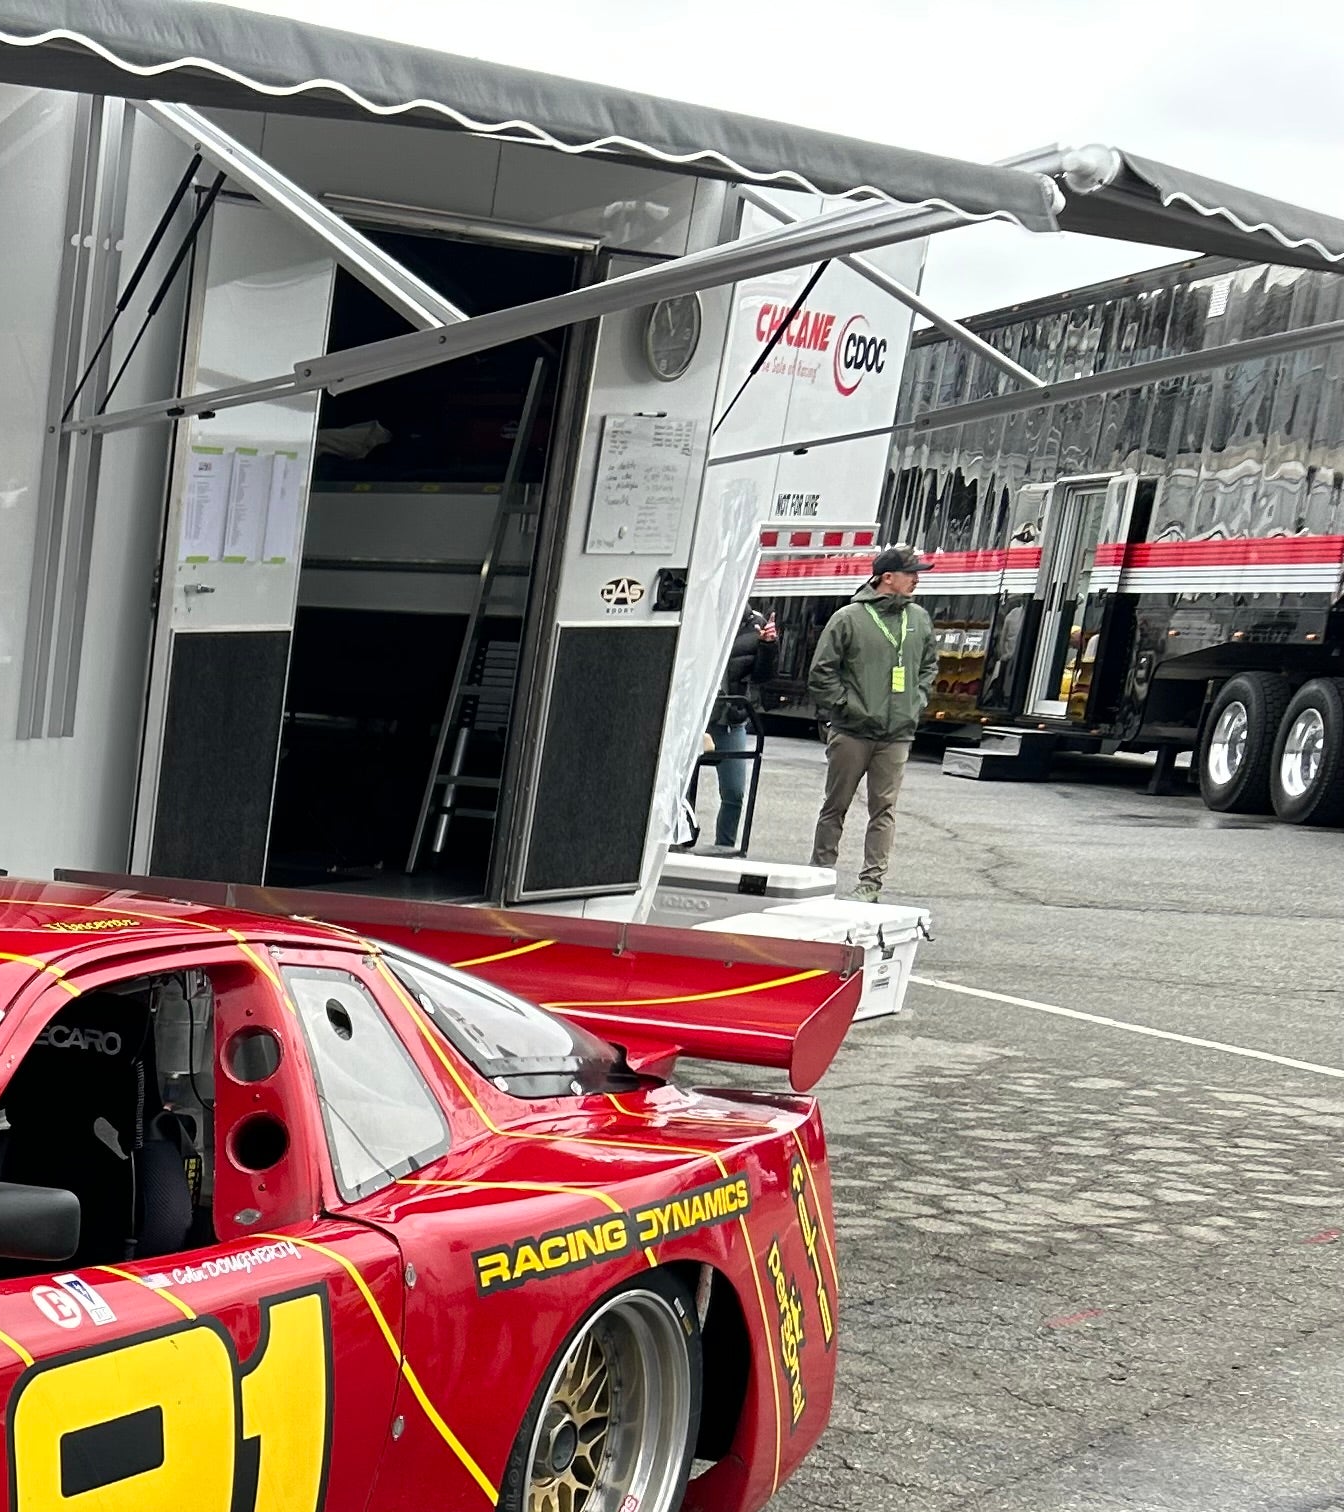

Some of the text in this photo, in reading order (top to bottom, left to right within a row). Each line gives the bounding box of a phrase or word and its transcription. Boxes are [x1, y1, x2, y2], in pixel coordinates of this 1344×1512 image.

[754, 302, 837, 352] CHCANE
[844, 332, 888, 374] CDOC
[600, 578, 645, 605] DAS
[34, 1024, 122, 1056] ECARO
[478, 1179, 750, 1289] RACING DYNAMICS
[36, 1289, 78, 1322] E
[768, 1239, 805, 1424] personal
